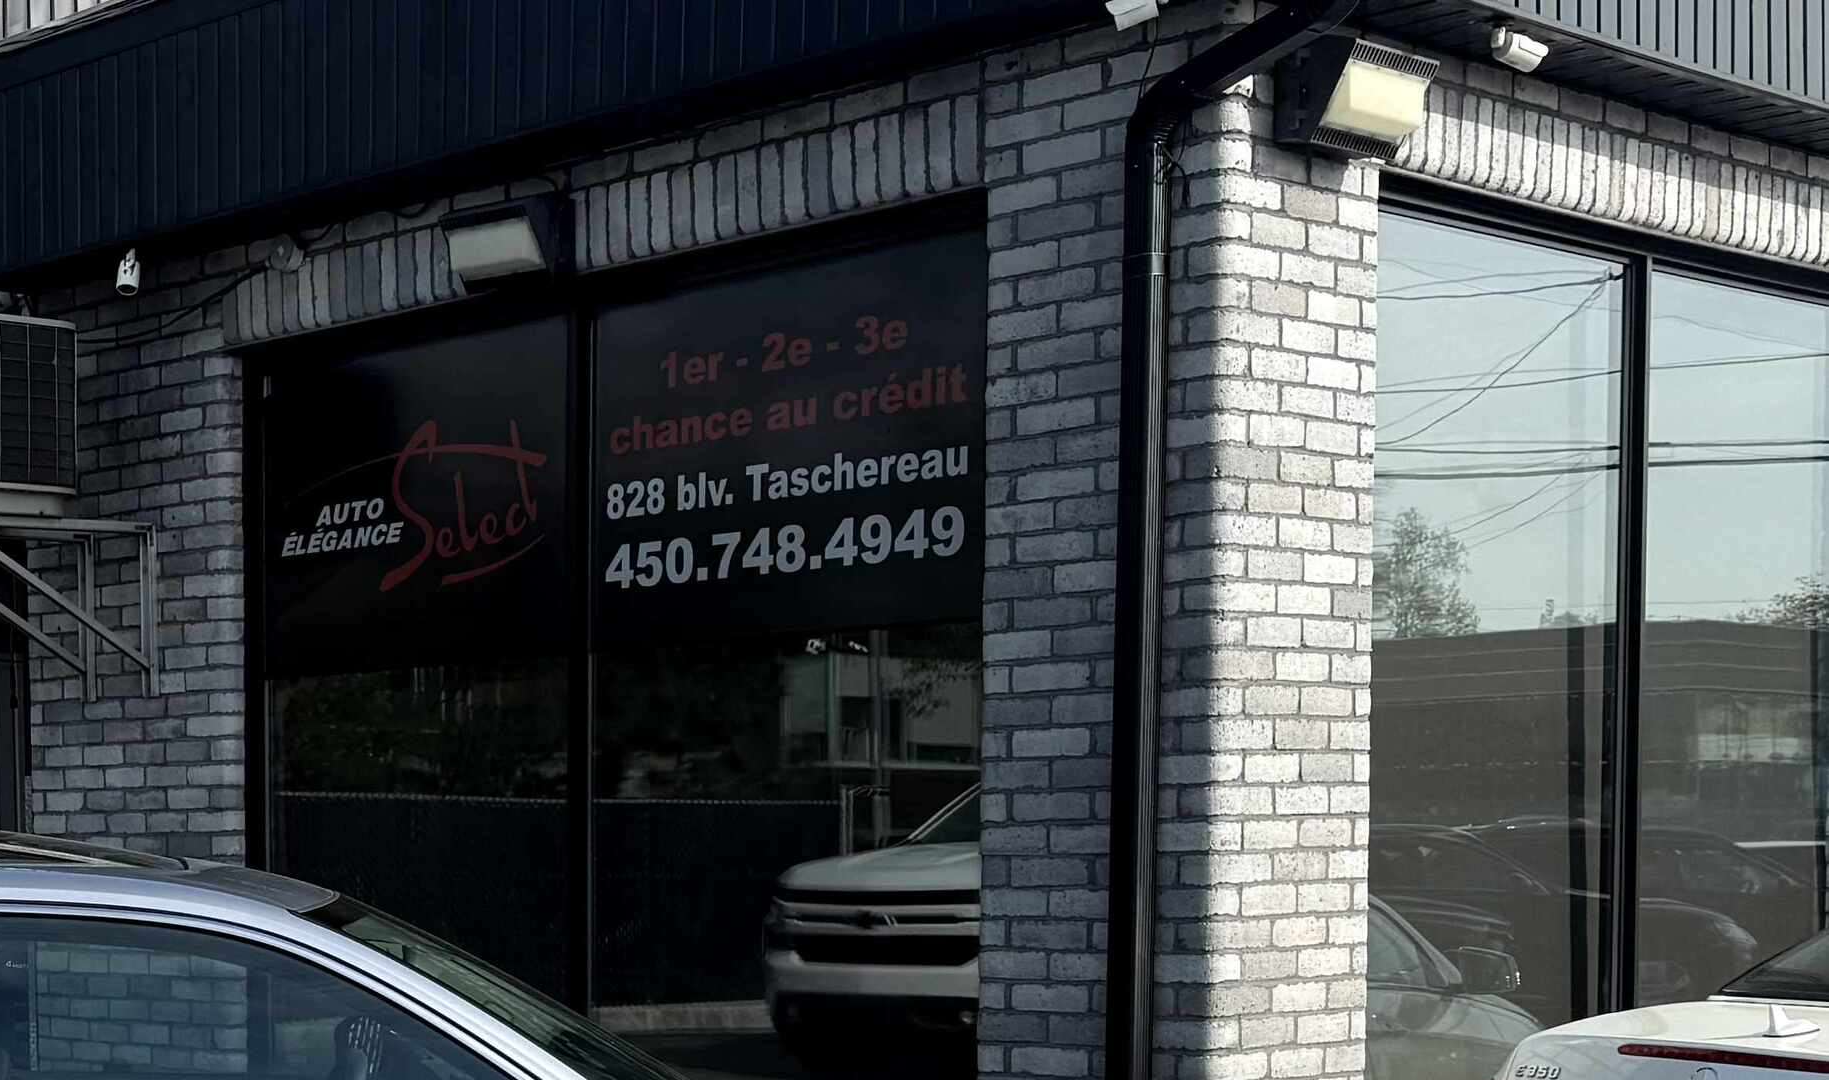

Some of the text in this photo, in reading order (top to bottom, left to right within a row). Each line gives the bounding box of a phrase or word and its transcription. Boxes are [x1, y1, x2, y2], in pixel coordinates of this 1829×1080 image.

[660, 350, 725, 390] 1er
[762, 332, 812, 373] 2e
[855, 315, 908, 354] 3e
[608, 363, 970, 456] chance au crédit
[315, 497, 385, 528] AUTO
[379, 418, 546, 592] Select
[605, 444, 970, 520] 828 blv. Taschereau
[281, 521, 405, 558] ÉLÉGANCE
[604, 505, 966, 590] 450.748.4949
